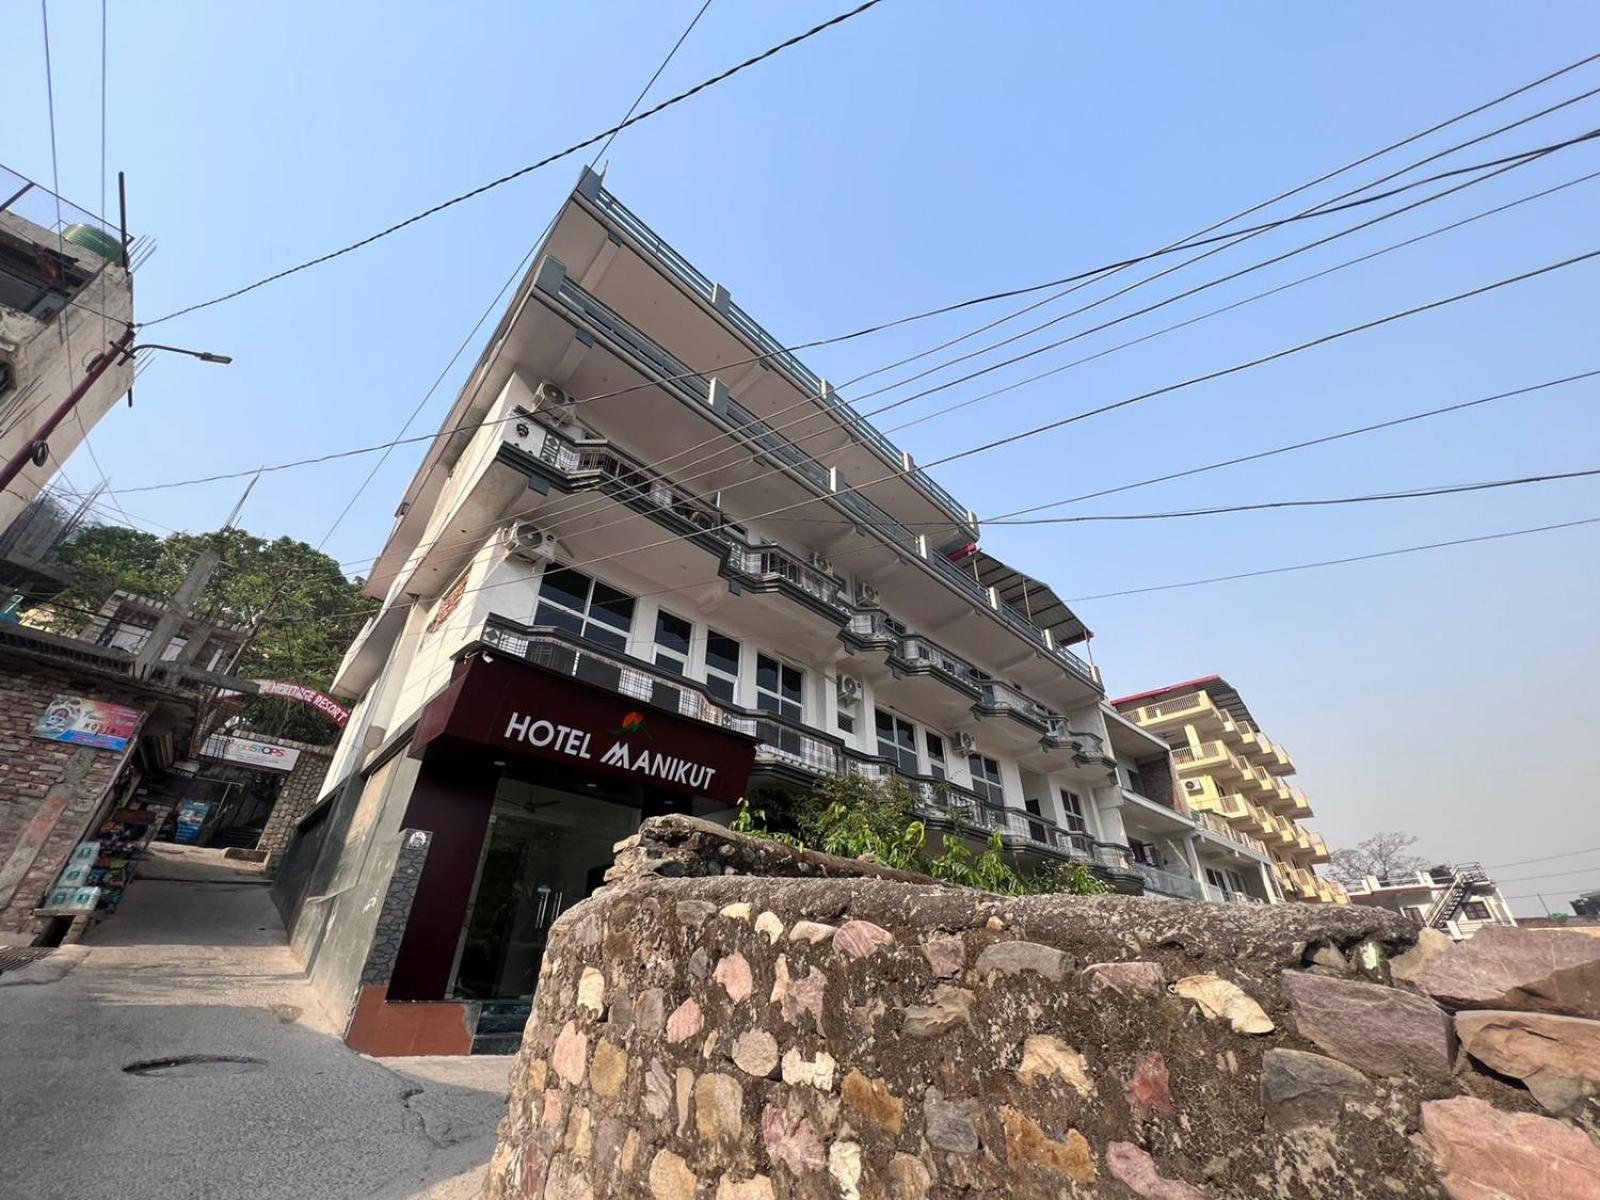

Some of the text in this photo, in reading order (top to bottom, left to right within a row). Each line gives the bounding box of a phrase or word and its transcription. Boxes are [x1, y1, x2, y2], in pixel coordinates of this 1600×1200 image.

[312, 695, 348, 722] RESORT
[504, 712, 716, 790] HOTEL MANIKUT
